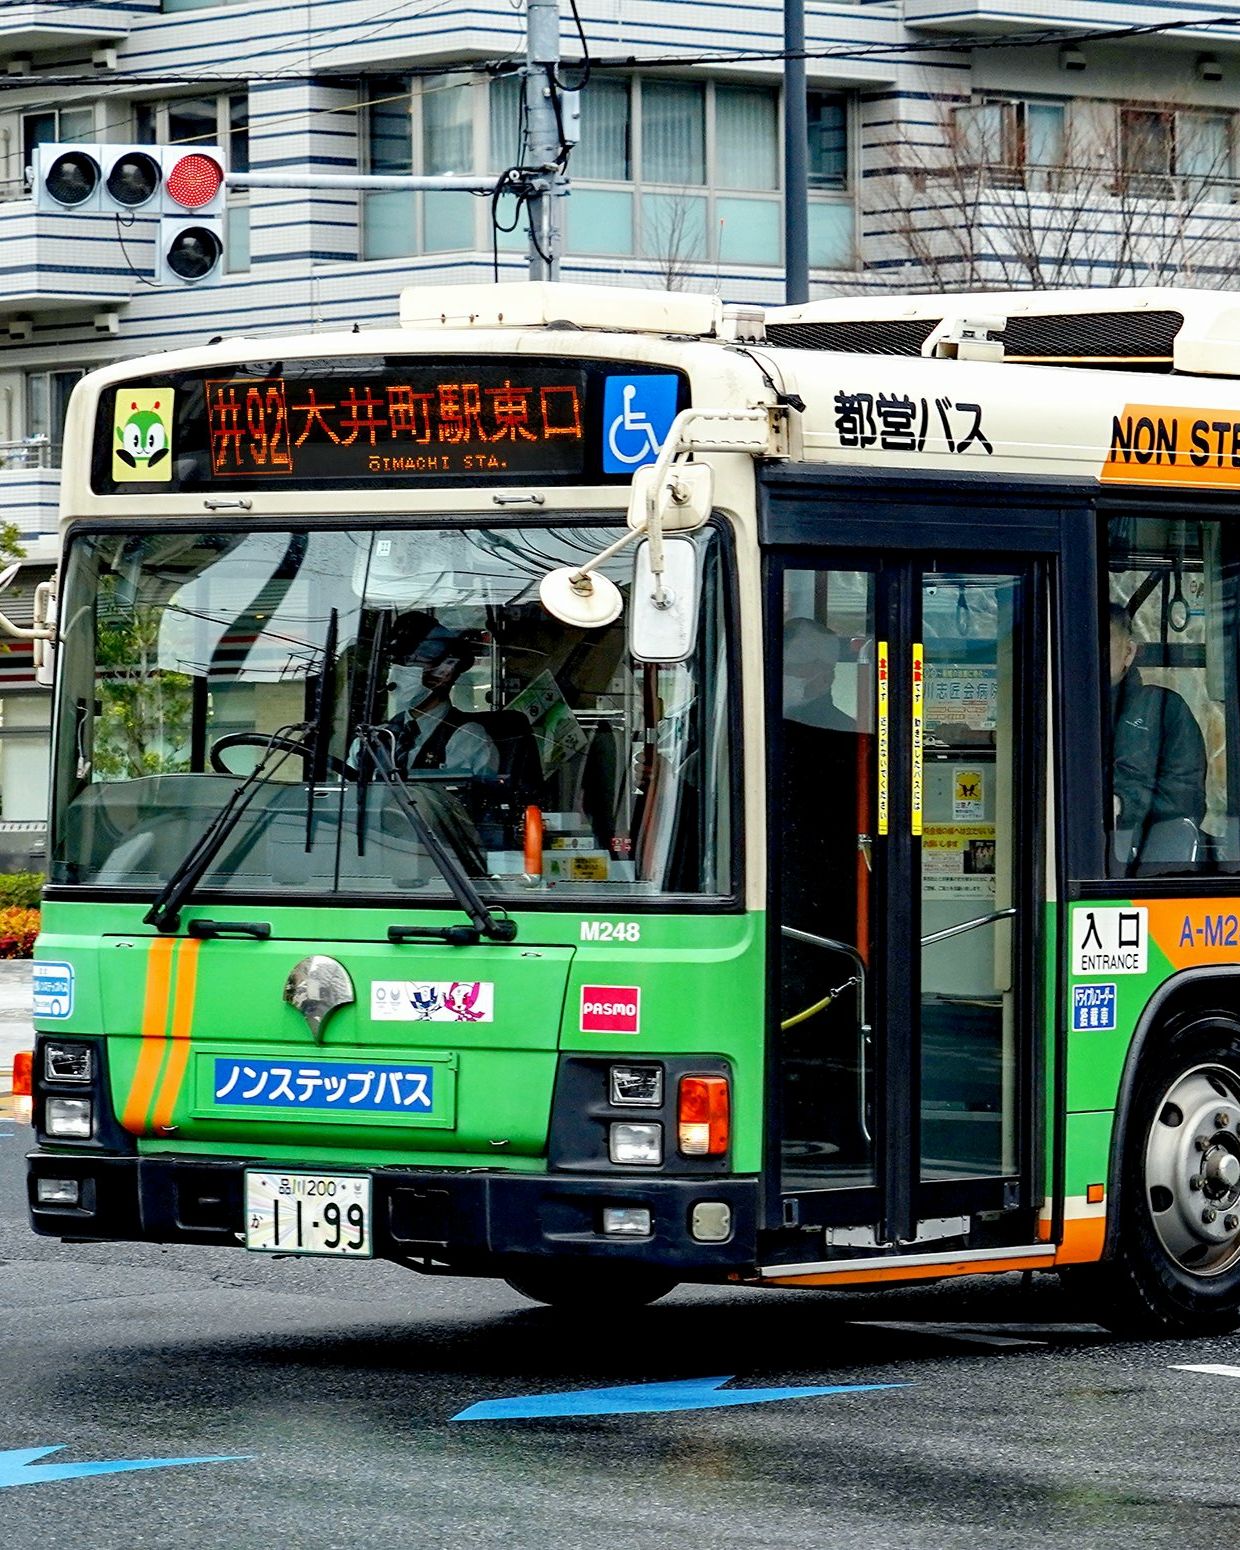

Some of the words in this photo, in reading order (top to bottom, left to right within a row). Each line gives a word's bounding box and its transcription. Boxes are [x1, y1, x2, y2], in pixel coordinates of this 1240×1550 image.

[292, 380, 583, 446] 大井町駅東口
[834, 390, 994, 455] 都営バス
[1111, 415, 1178, 465] NON
[464, 454, 508, 470] STA.
[580, 921, 641, 942] M248
[1081, 911, 1140, 950] 入口
[1081, 953, 1140, 972] ENTRANCE
[583, 1002, 637, 1017] PASMO
[215, 1065, 432, 1107] ノンステップバス
